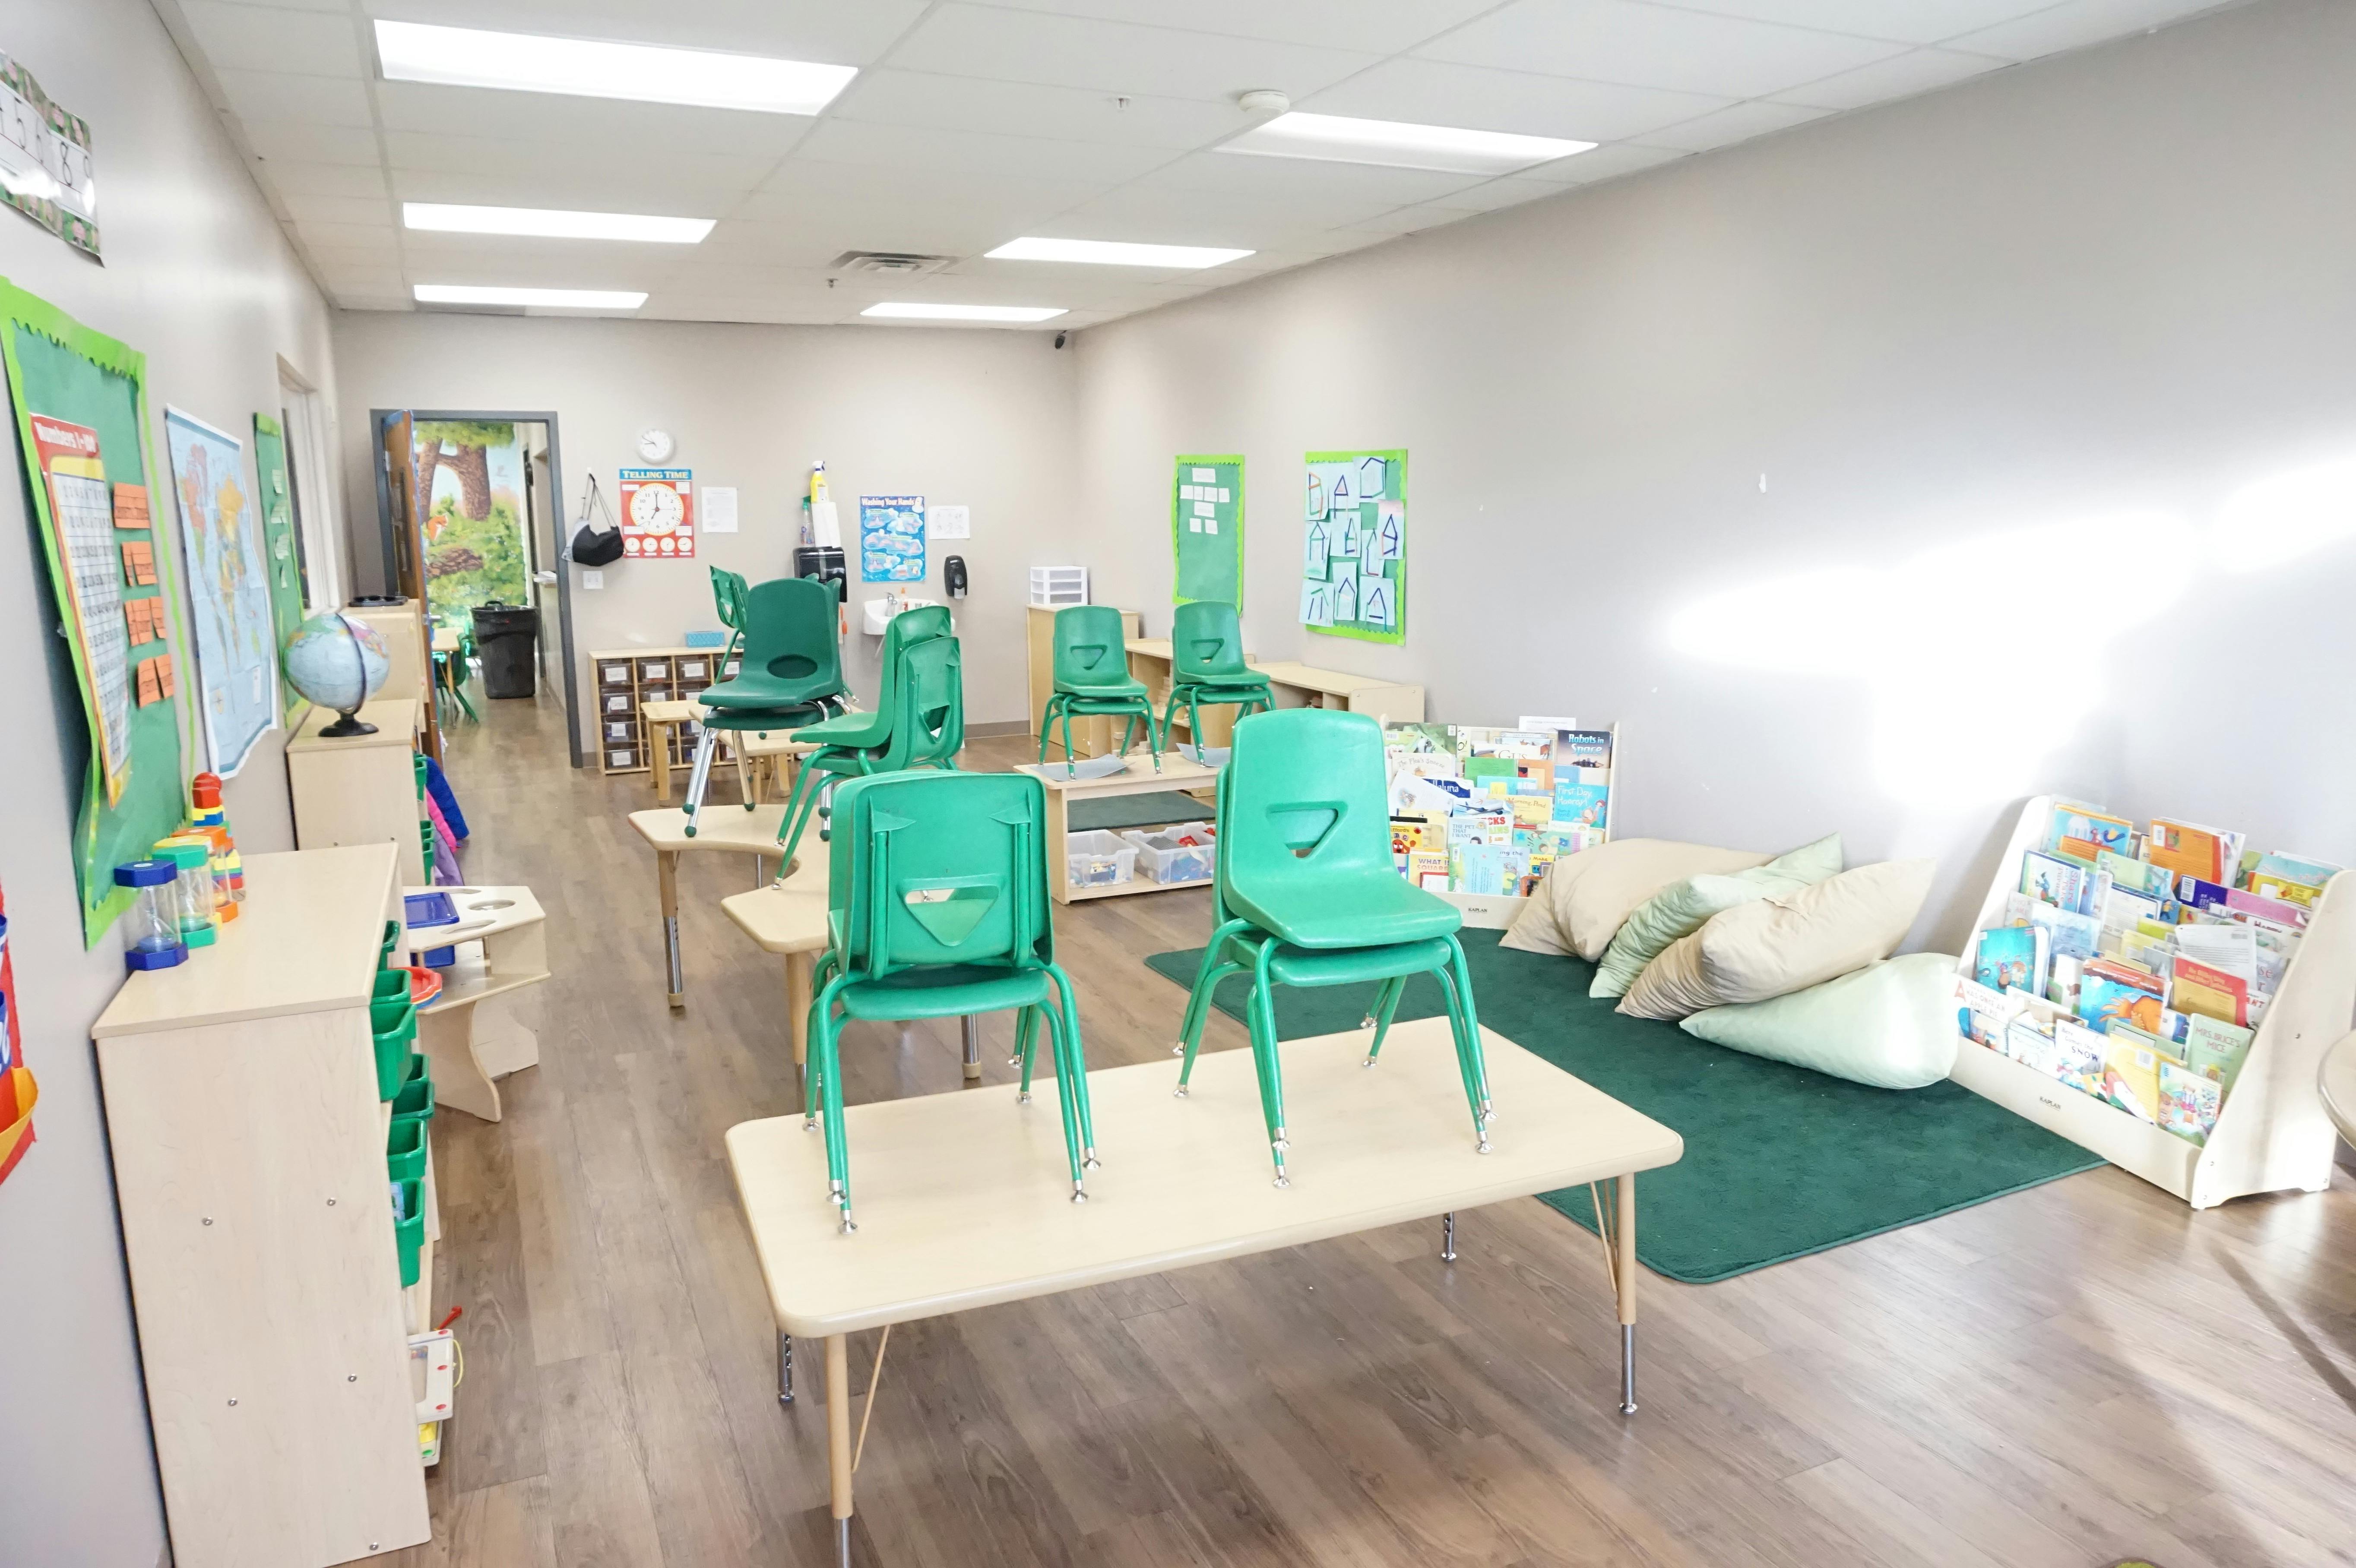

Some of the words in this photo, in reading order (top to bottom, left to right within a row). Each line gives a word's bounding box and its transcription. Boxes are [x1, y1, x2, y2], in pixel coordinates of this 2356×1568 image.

[622, 471, 663, 479] TELLING
[664, 471, 689, 479] TIME
[861, 498, 885, 507] Washing
[1568, 733, 1596, 744] Robots
[1571, 743, 1603, 756] Space
[1558, 785, 1574, 795] First
[1533, 800, 1547, 809] Pond
[2207, 1040, 2226, 1053] MICE
[2071, 1046, 2099, 1062] SNOW
[2039, 1096, 2061, 1110] KAPLAN
